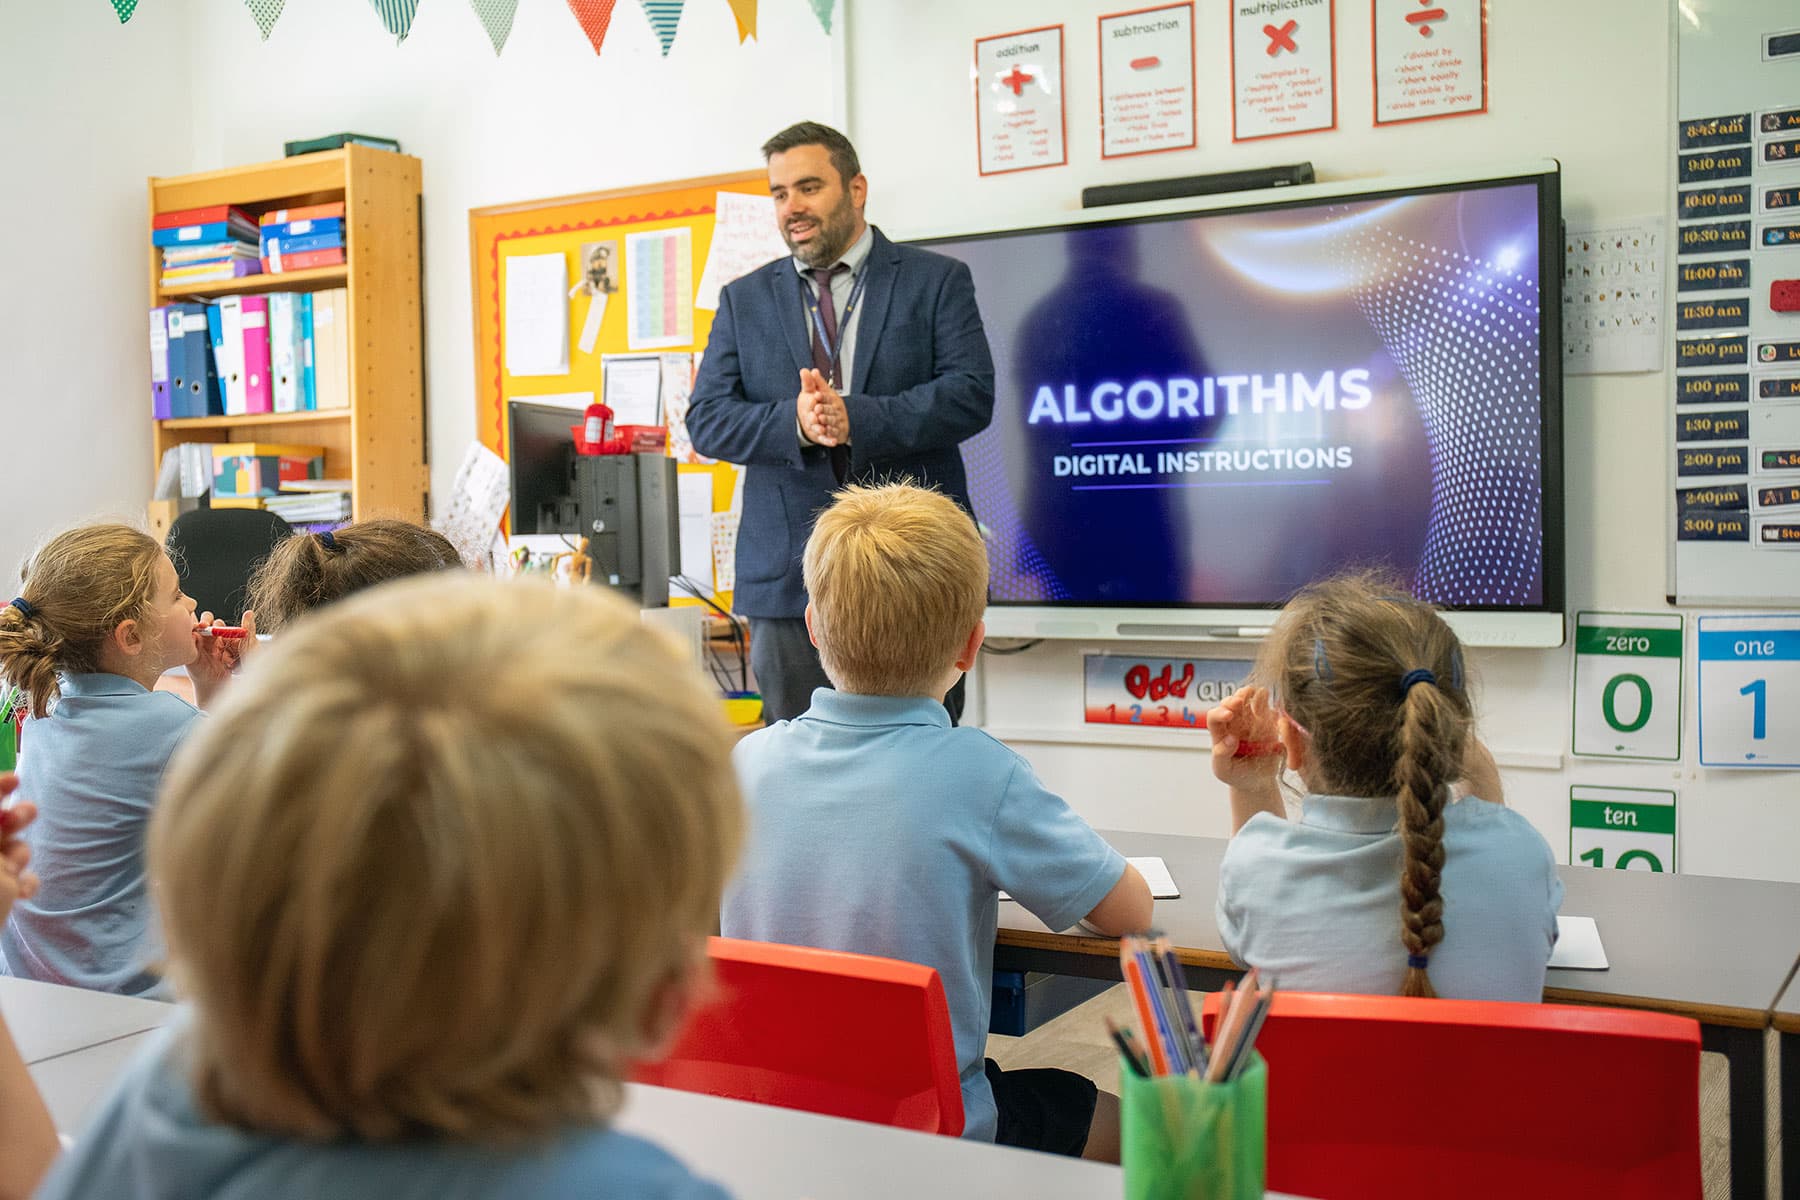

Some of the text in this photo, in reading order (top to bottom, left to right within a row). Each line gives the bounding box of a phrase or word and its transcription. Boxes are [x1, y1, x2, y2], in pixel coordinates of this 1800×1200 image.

[1112, 19, 1179, 38] subtraction
[996, 43, 1040, 58] addition
[1400, 64, 1423, 73] share
[1404, 71, 1459, 85] share equally
[1448, 94, 1473, 105] group
[1686, 121, 1744, 138] 8:45 am
[1688, 157, 1742, 172] 9:10 am
[1684, 193, 1743, 208] 10:10 am
[1684, 229, 1746, 244] 10:30 am
[1684, 265, 1743, 281] 11:00 am
[1683, 305, 1741, 318] 11:30 am
[1681, 342, 1744, 358] 12:00 pm
[1685, 380, 1740, 395] 1:00 pm
[1028, 369, 1373, 424] ALGORITHMS
[1685, 418, 1739, 433] 1:30 pm
[1054, 446, 1353, 476] DIGITAL INSTRUCTIONS
[1683, 453, 1741, 468] 2:00 pm
[1684, 519, 1742, 534] 3:00 pm
[1606, 636, 1650, 652] zero
[1734, 638, 1775, 656] one
[1124, 662, 1237, 702] Odd an
[1602, 673, 1653, 733] 0
[1739, 679, 1766, 740] 1
[1106, 703, 1196, 725] 1 2 3 4
[1604, 806, 1638, 827] ten
